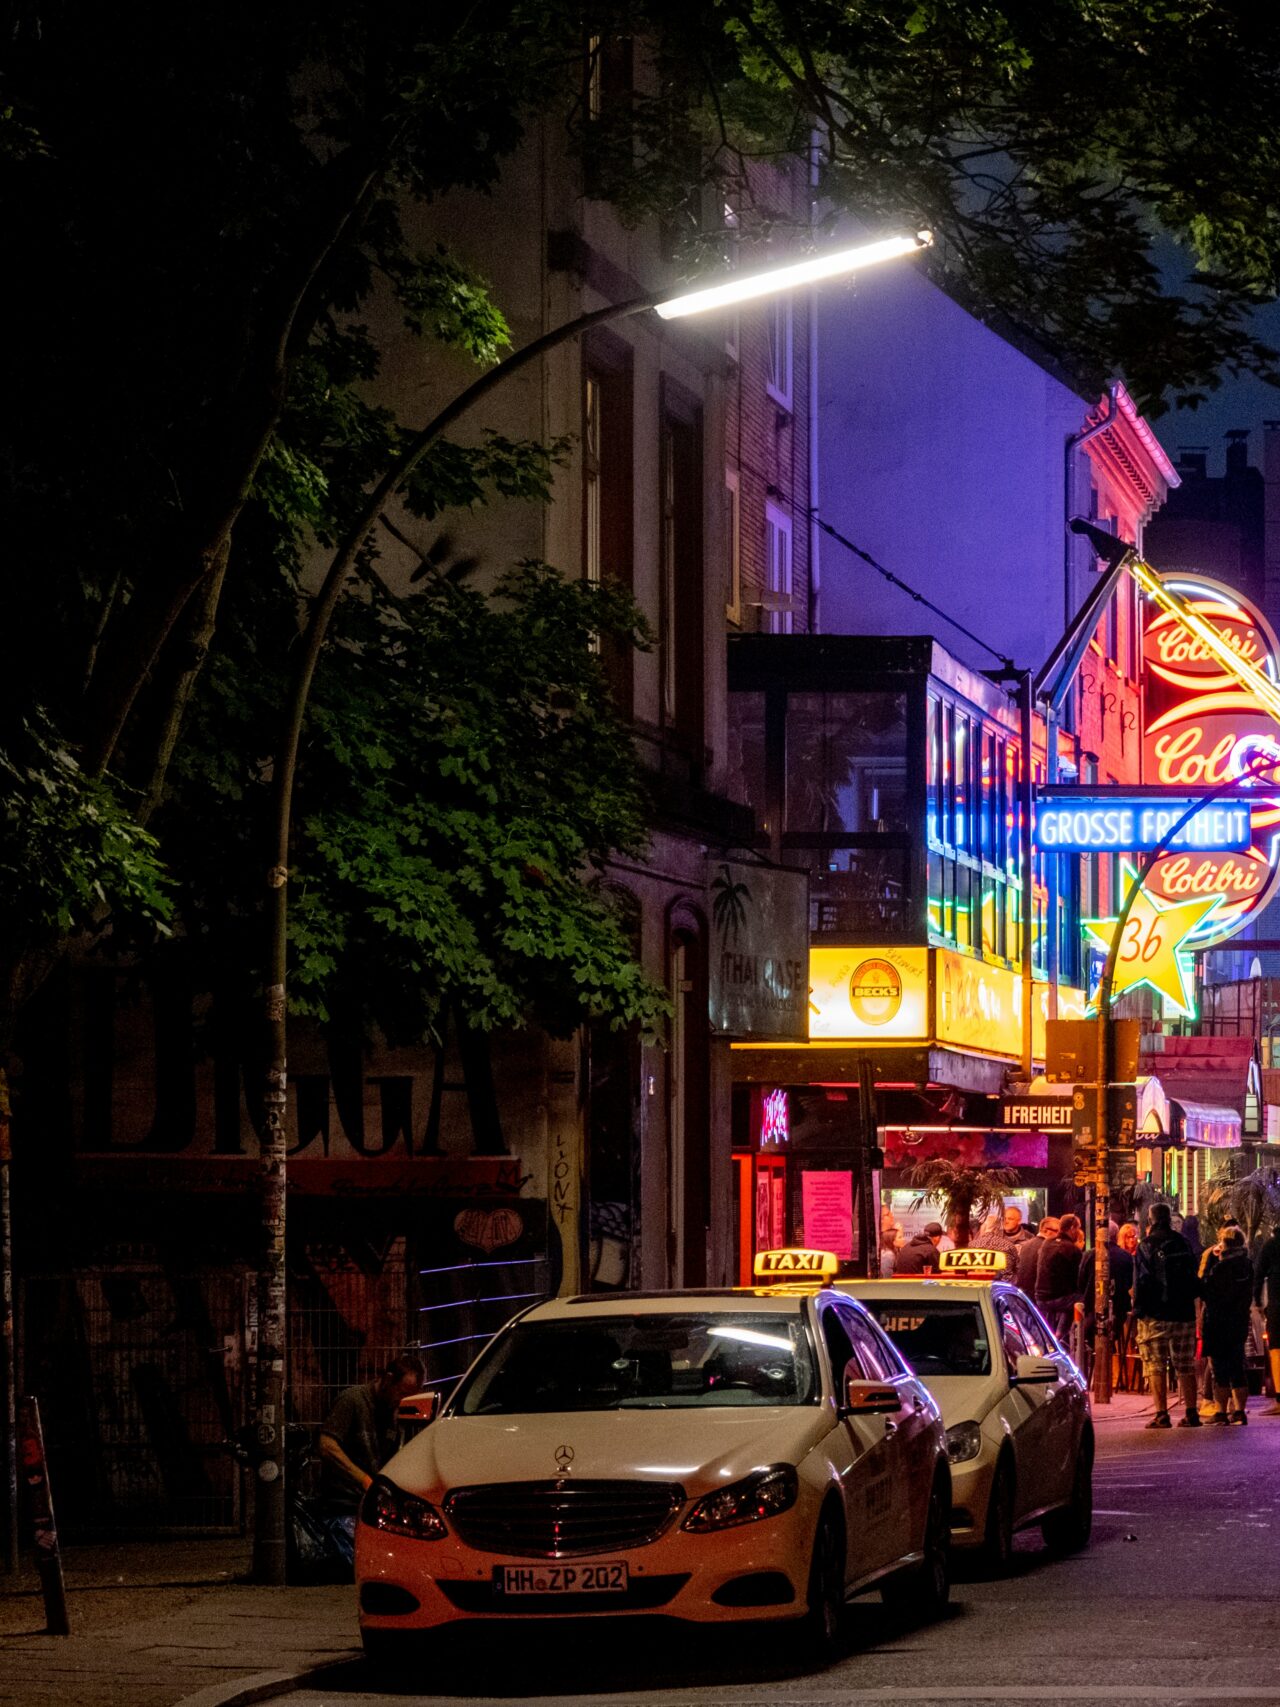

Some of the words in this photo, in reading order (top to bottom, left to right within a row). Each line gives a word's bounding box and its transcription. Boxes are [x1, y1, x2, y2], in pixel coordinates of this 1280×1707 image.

[1040, 811, 1132, 845] GROSSE
[1161, 857, 1260, 896] Colibri
[1120, 916, 1162, 962] 36
[853, 986, 898, 997] BECK'S
[1012, 1105, 1073, 1124] FREIHEIT
[767, 1253, 821, 1270] TAXI
[949, 1251, 997, 1267] TAXI
[507, 1569, 533, 1591] HH
[548, 1568, 576, 1591] ZP
[582, 1566, 623, 1589] 202
